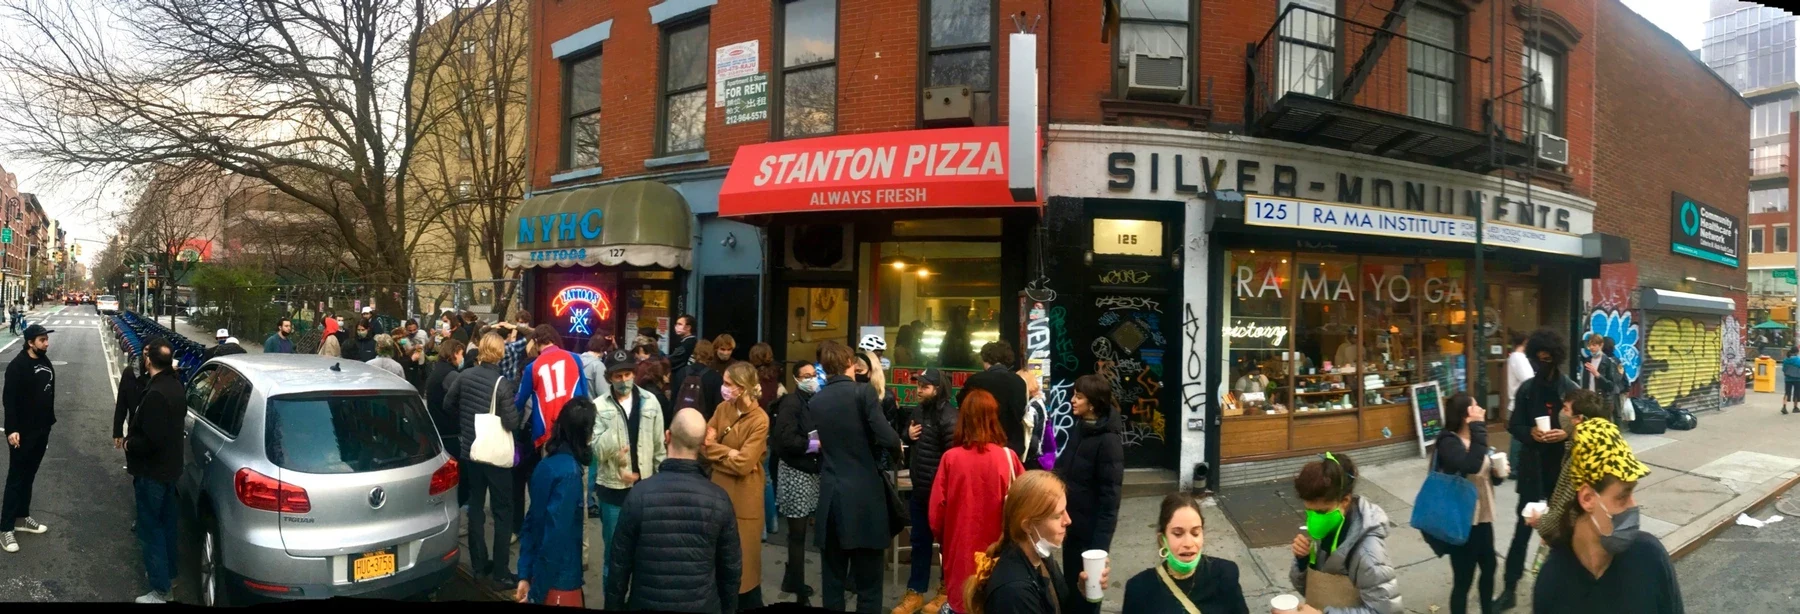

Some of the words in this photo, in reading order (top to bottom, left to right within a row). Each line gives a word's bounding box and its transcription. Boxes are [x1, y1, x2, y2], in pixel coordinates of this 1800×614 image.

[726, 86, 742, 99] FOR
[744, 81, 768, 96] RENT
[727, 78, 749, 87] Apartment
[754, 74, 767, 82] Store
[726, 110, 767, 125] 212-964-5578
[754, 145, 896, 187] STANTON
[904, 141, 1004, 177] PIZZA
[809, 189, 872, 206] ALWAYS
[876, 187, 927, 204] FRESH
[518, 208, 604, 244] NYHC
[1254, 201, 1288, 220] 125
[1313, 207, 1337, 225] RA
[1343, 211, 1374, 228] MA
[1379, 213, 1456, 236] INSTITUTE
[1700, 206, 1733, 230] Community
[1700, 217, 1732, 237] Healthcare
[1118, 234, 1138, 245] 125
[1461, 222, 1475, 230] FOR
[1522, 230, 1546, 241] SCIENCE
[1700, 227, 1726, 244] Network
[530, 248, 587, 262] TATTOOS
[609, 248, 626, 258] 127
[561, 286, 601, 305] TATTOOS
[1222, 320, 1288, 347] victory
[537, 359, 567, 403] 11
[355, 555, 393, 577] HUC-3758
